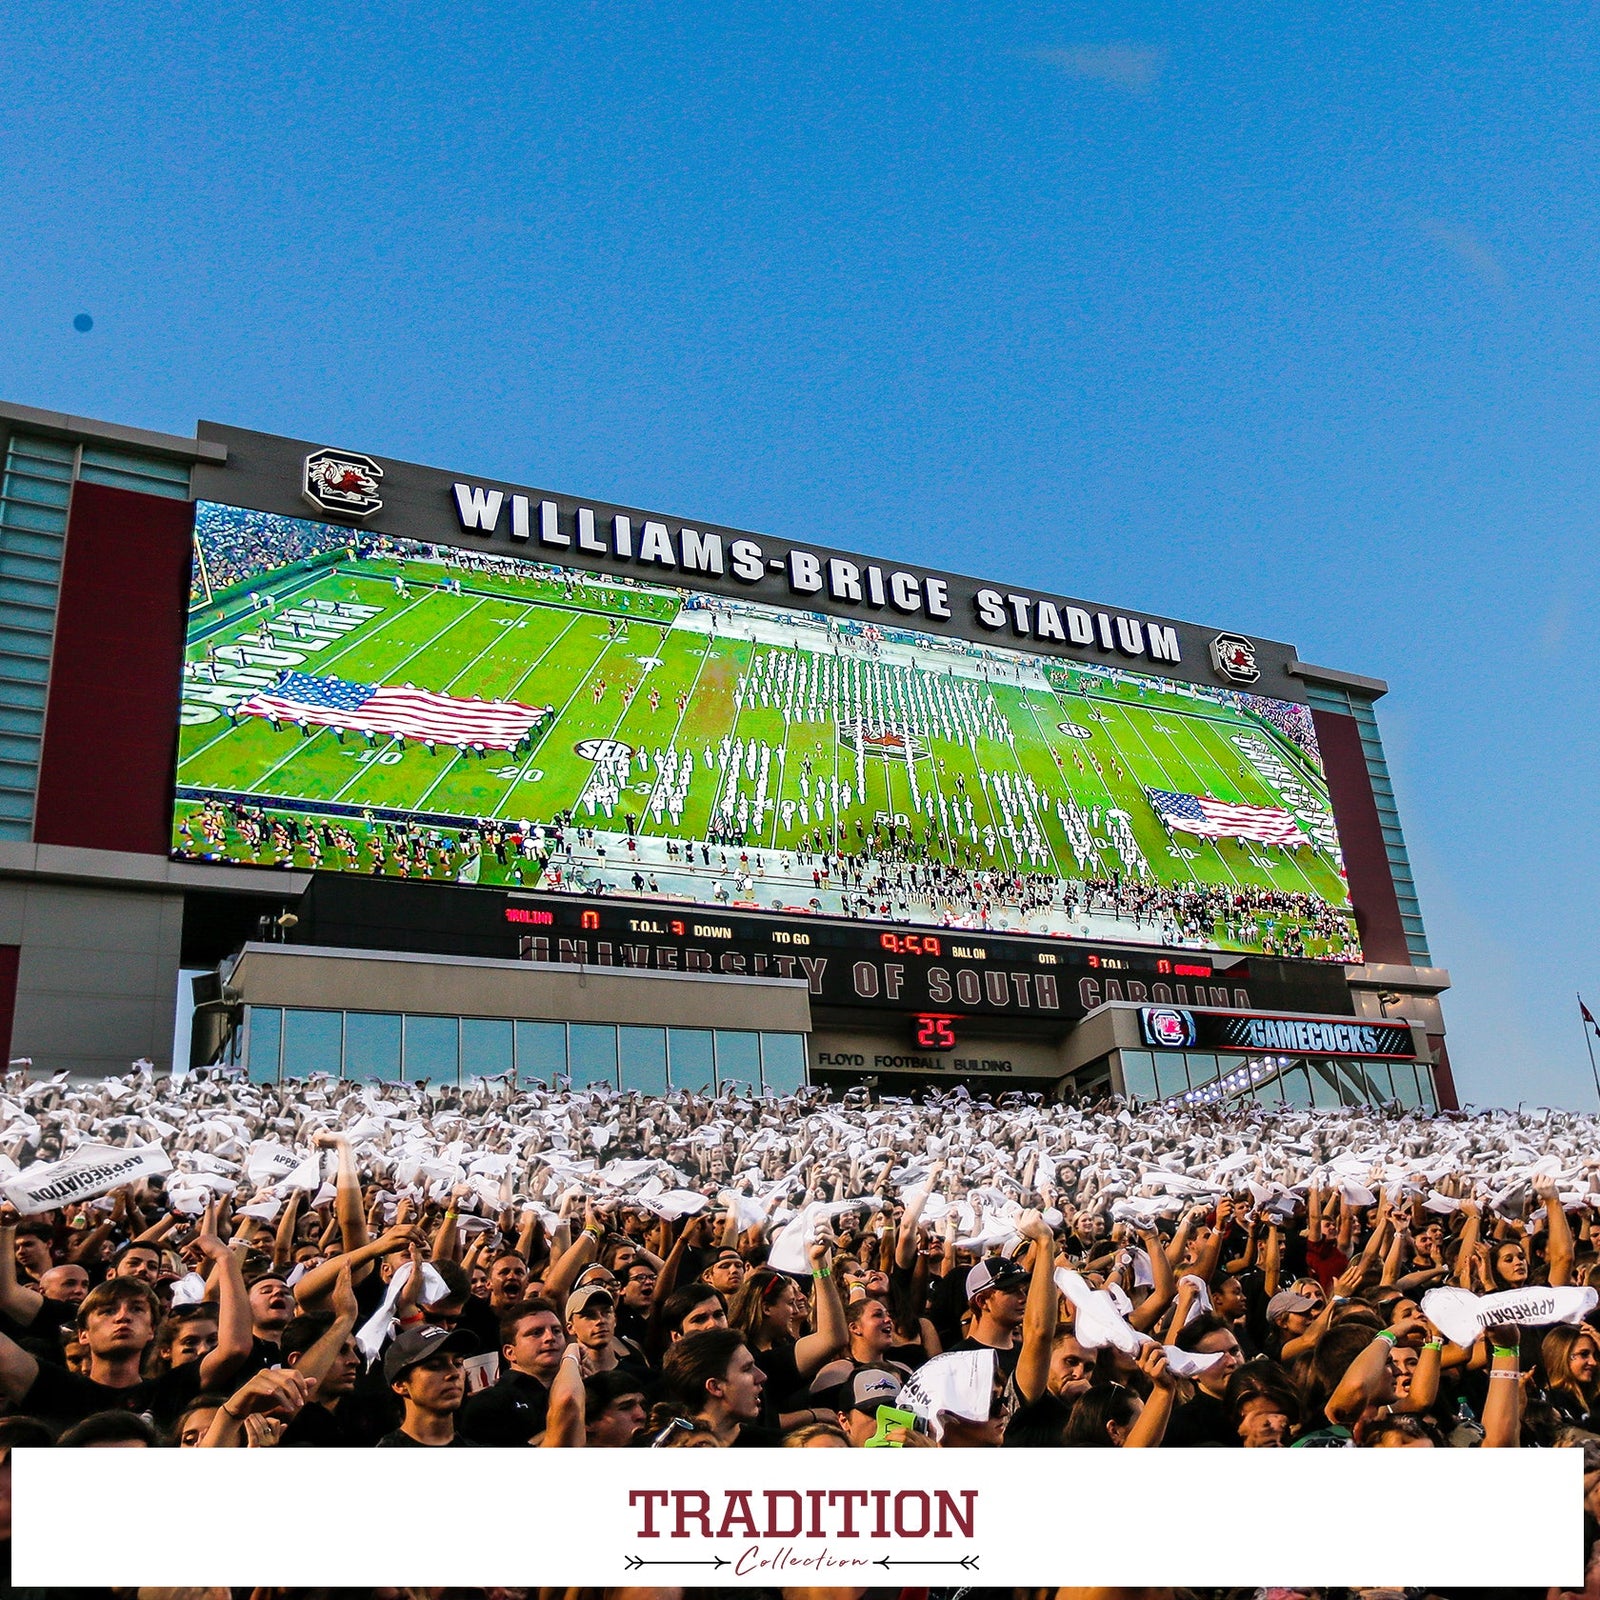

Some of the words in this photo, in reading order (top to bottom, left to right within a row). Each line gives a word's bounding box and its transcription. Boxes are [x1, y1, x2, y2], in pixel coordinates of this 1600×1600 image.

[454, 482, 952, 622] WILLIAMS-BRICE
[977, 587, 1182, 664] STADIUM
[1058, 723, 1091, 739] SEC
[496, 766, 545, 782] 20
[1165, 846, 1195, 860] 20
[629, 919, 664, 934] T.O.L.
[693, 923, 732, 940] DOWN
[775, 931, 790, 944] TO
[793, 932, 811, 946] GO
[880, 932, 941, 957] 9:59
[952, 944, 968, 959] BALL
[968, 946, 986, 961] ON
[852, 960, 904, 1000] OF
[927, 967, 1060, 1010] SOUTH
[1078, 976, 1252, 1012] CAROLINA
[917, 1018, 955, 1048] 25
[1249, 1018, 1379, 1054] GAMECOCKS
[819, 1052, 865, 1068] FLOYD
[875, 1054, 945, 1072] FOOTBALL
[954, 1057, 1014, 1073] BUILDING
[27, 1155, 144, 1203] APPRECIATION
